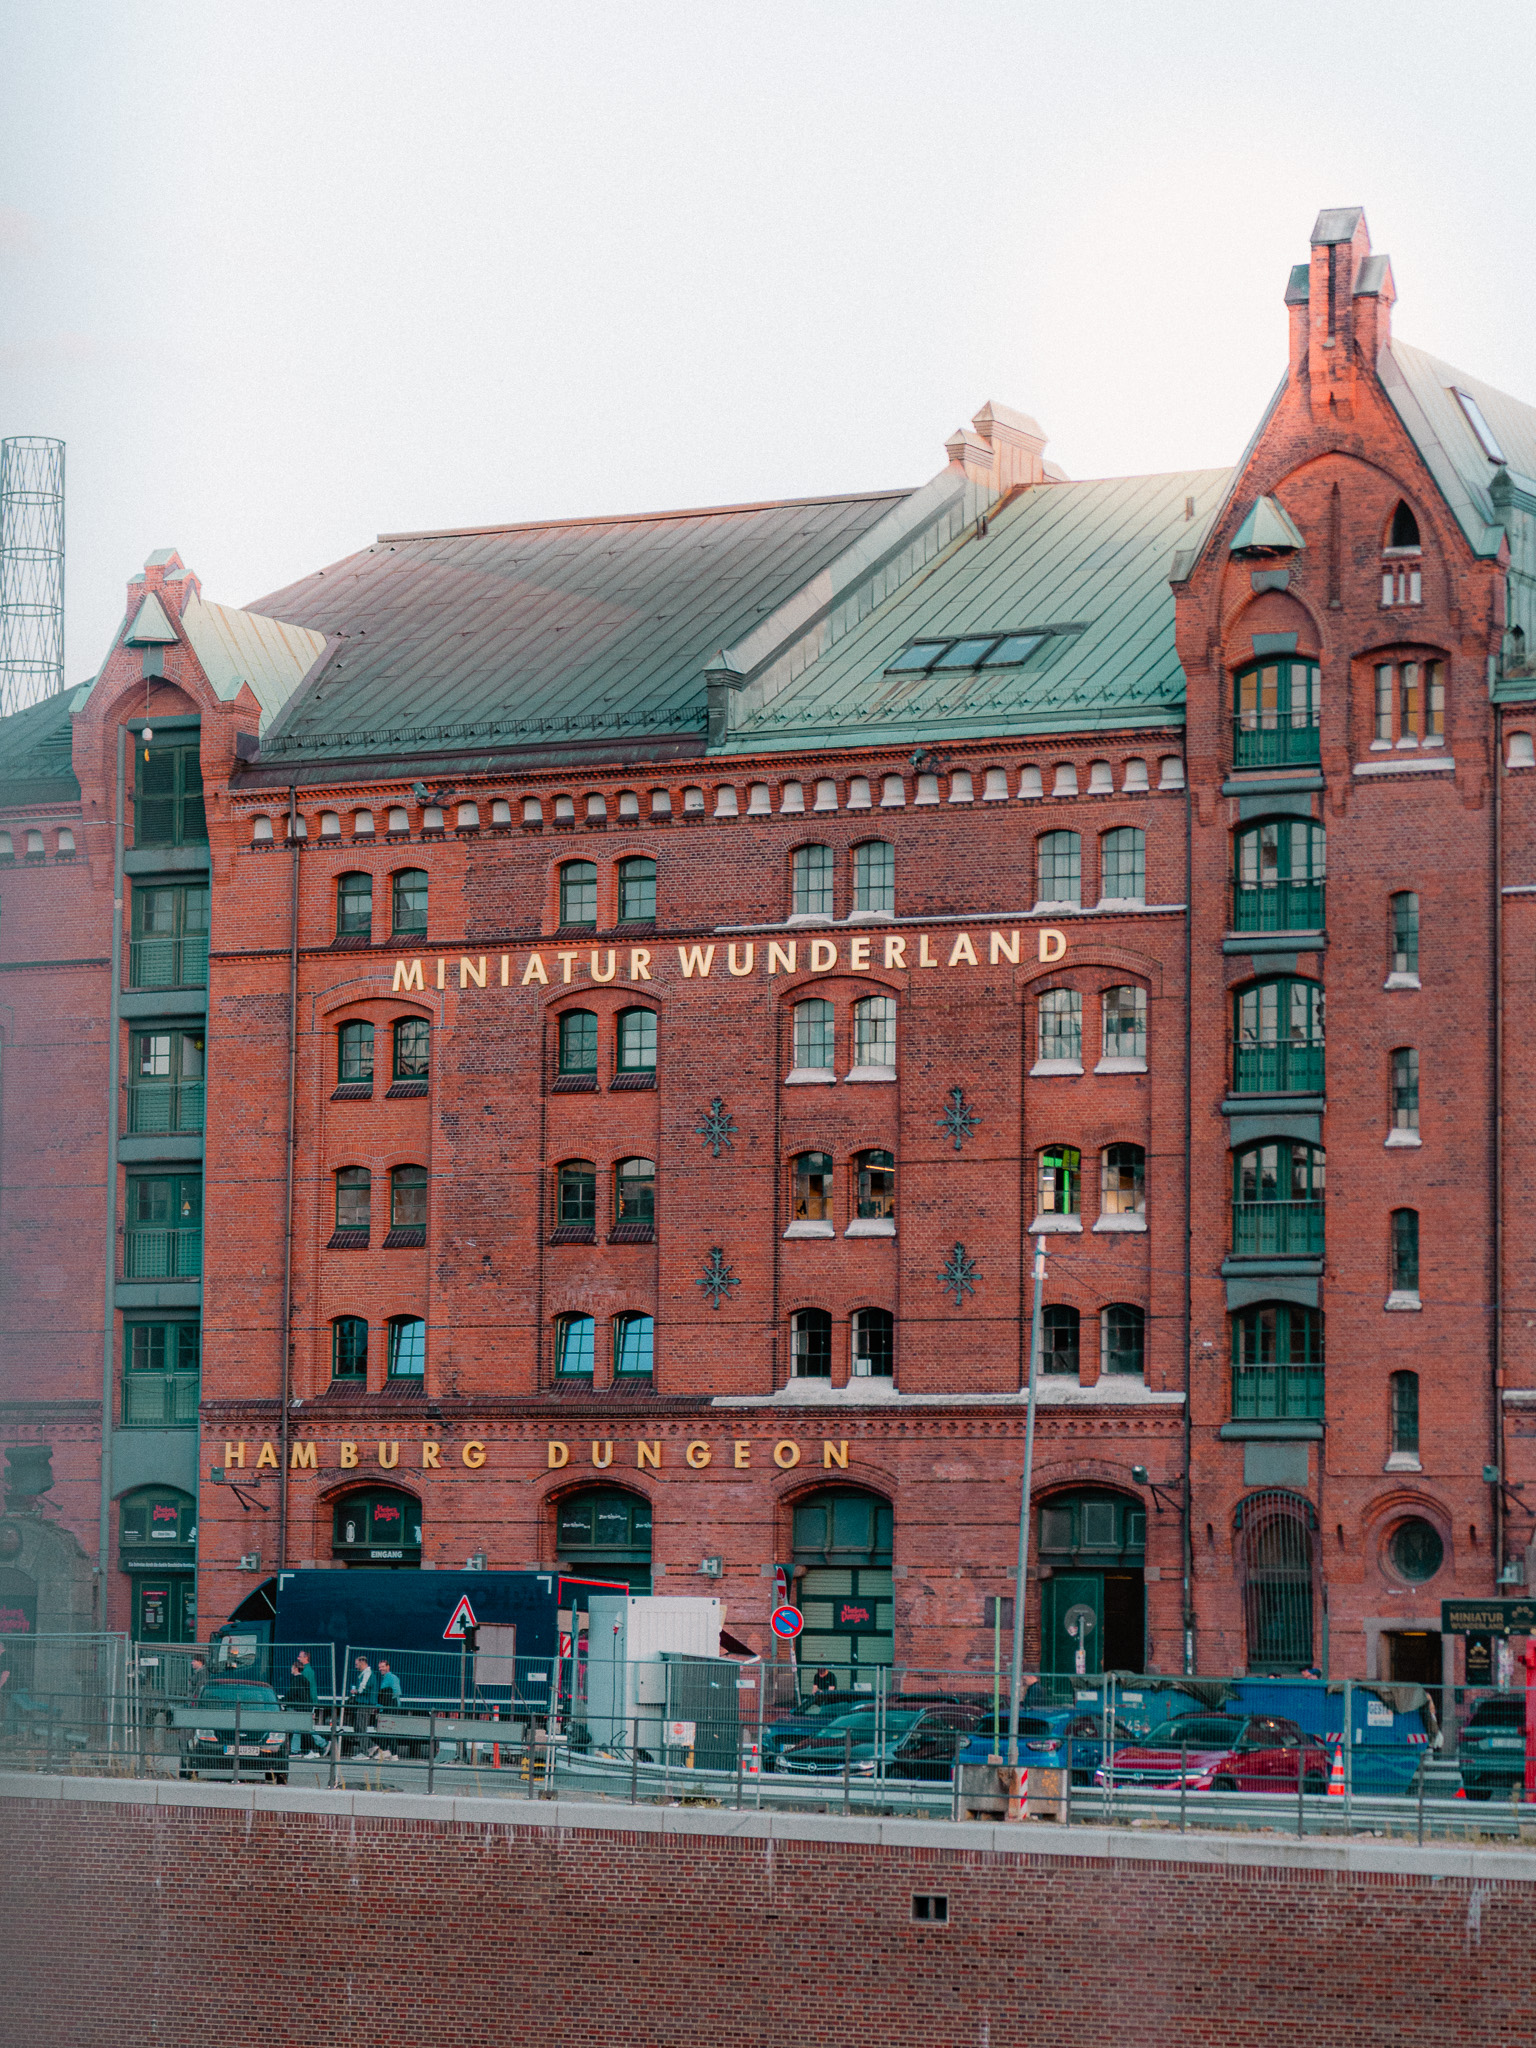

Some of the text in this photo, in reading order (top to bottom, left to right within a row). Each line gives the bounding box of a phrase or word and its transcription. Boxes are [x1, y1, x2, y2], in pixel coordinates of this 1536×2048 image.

[391, 928, 1068, 992] MINIATUR WUNDERLAND
[224, 1440, 849, 1469] HAMBURG DUNGEON
[371, 1550, 403, 1558] EINGANG
[1449, 1612, 1504, 1622] MINIATUR
